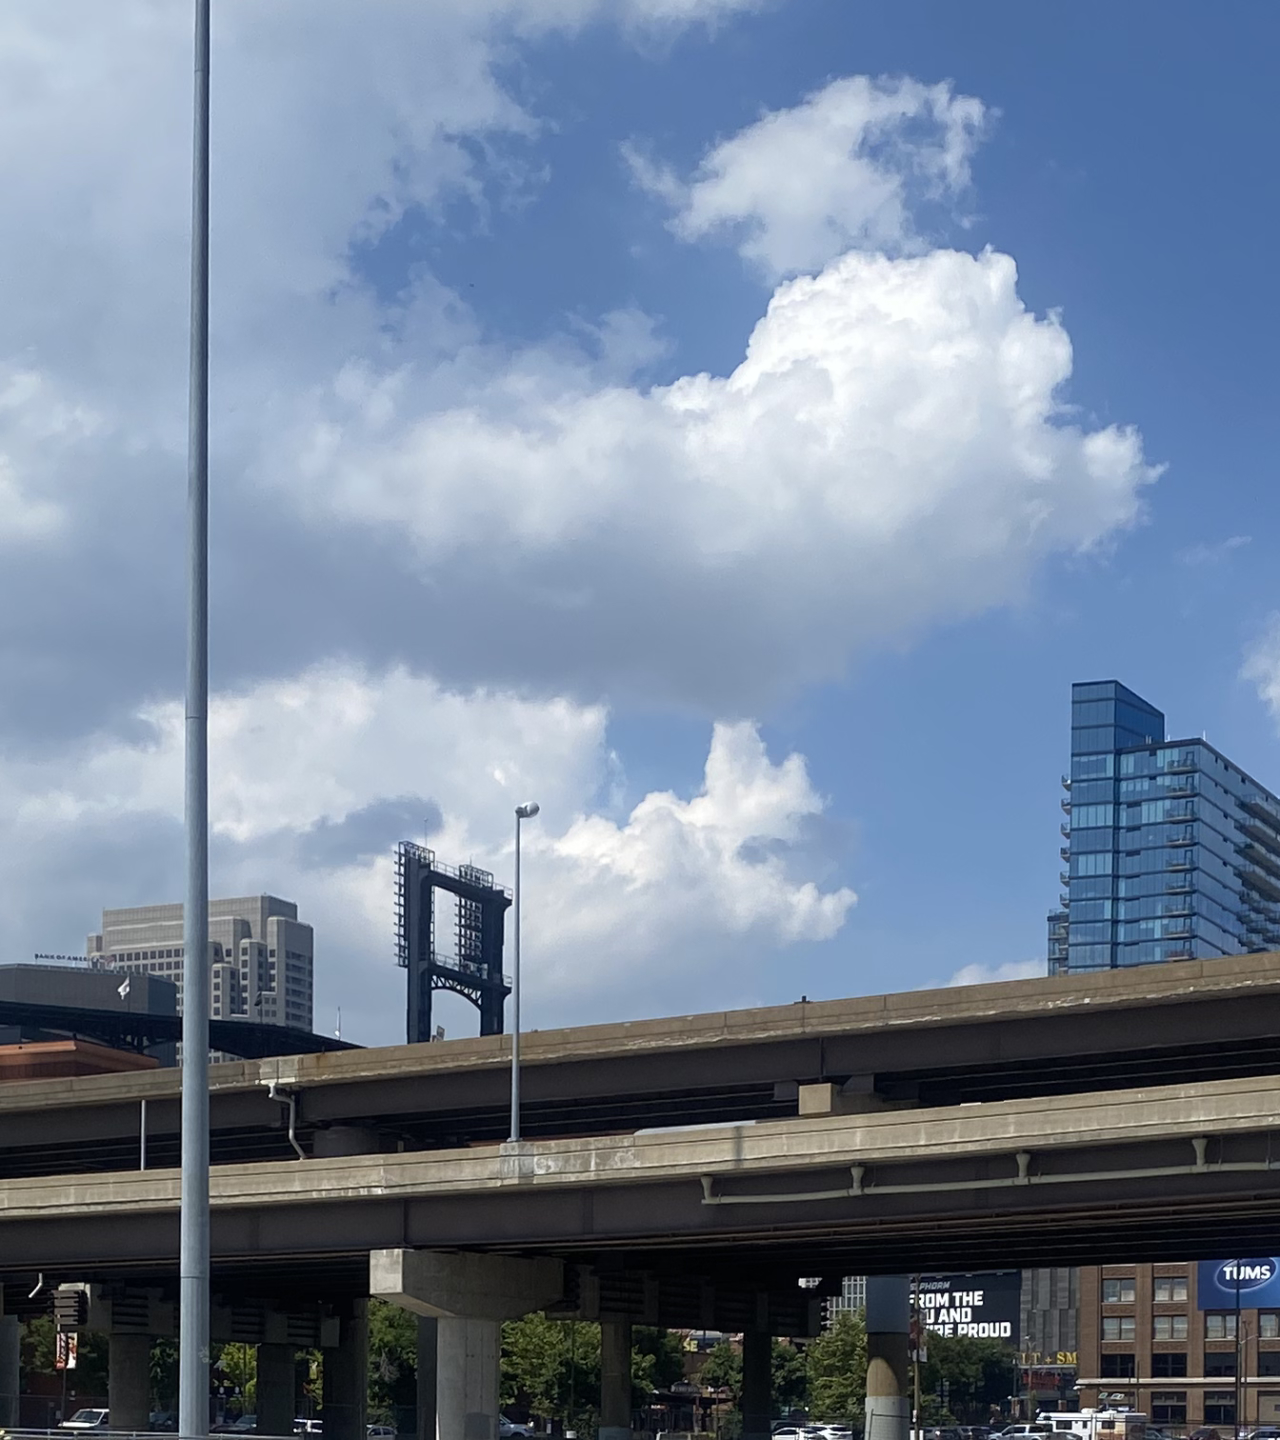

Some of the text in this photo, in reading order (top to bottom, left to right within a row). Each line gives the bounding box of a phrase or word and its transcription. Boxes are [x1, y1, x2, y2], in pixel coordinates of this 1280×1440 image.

[1222, 1265, 1271, 1280] TUMS
[952, 1290, 984, 1307] THE
[937, 1307, 972, 1323] AND
[957, 1322, 1011, 1338] PROUD
[1056, 1352, 1078, 1364] SM
